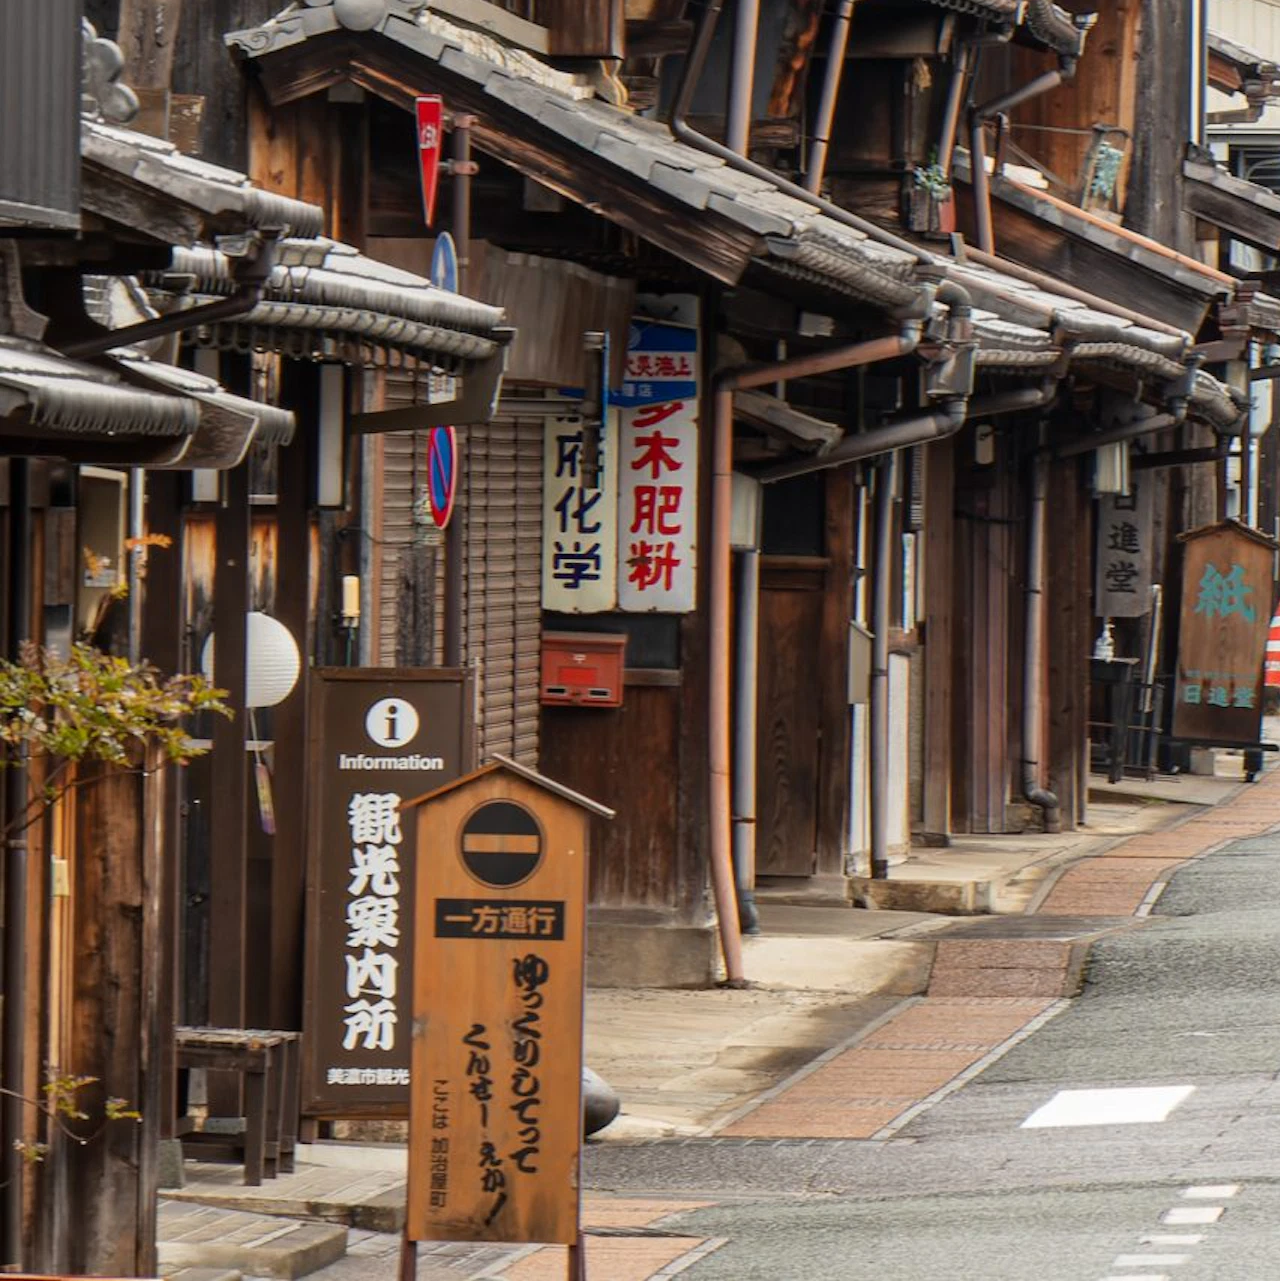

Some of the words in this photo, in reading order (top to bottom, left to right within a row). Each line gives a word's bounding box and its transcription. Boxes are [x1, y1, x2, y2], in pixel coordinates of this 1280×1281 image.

[552, 417, 604, 589] 府化学
[1194, 562, 1256, 624] 紙
[339, 754, 444, 771] Information
[343, 793, 403, 1051] 観光案内所
[445, 907, 555, 936] 一方通行
[510, 953, 549, 1174] ゆっくりしてって
[432, 1079, 449, 1129] ここは
[430, 1138, 449, 1208] 加治屋町
